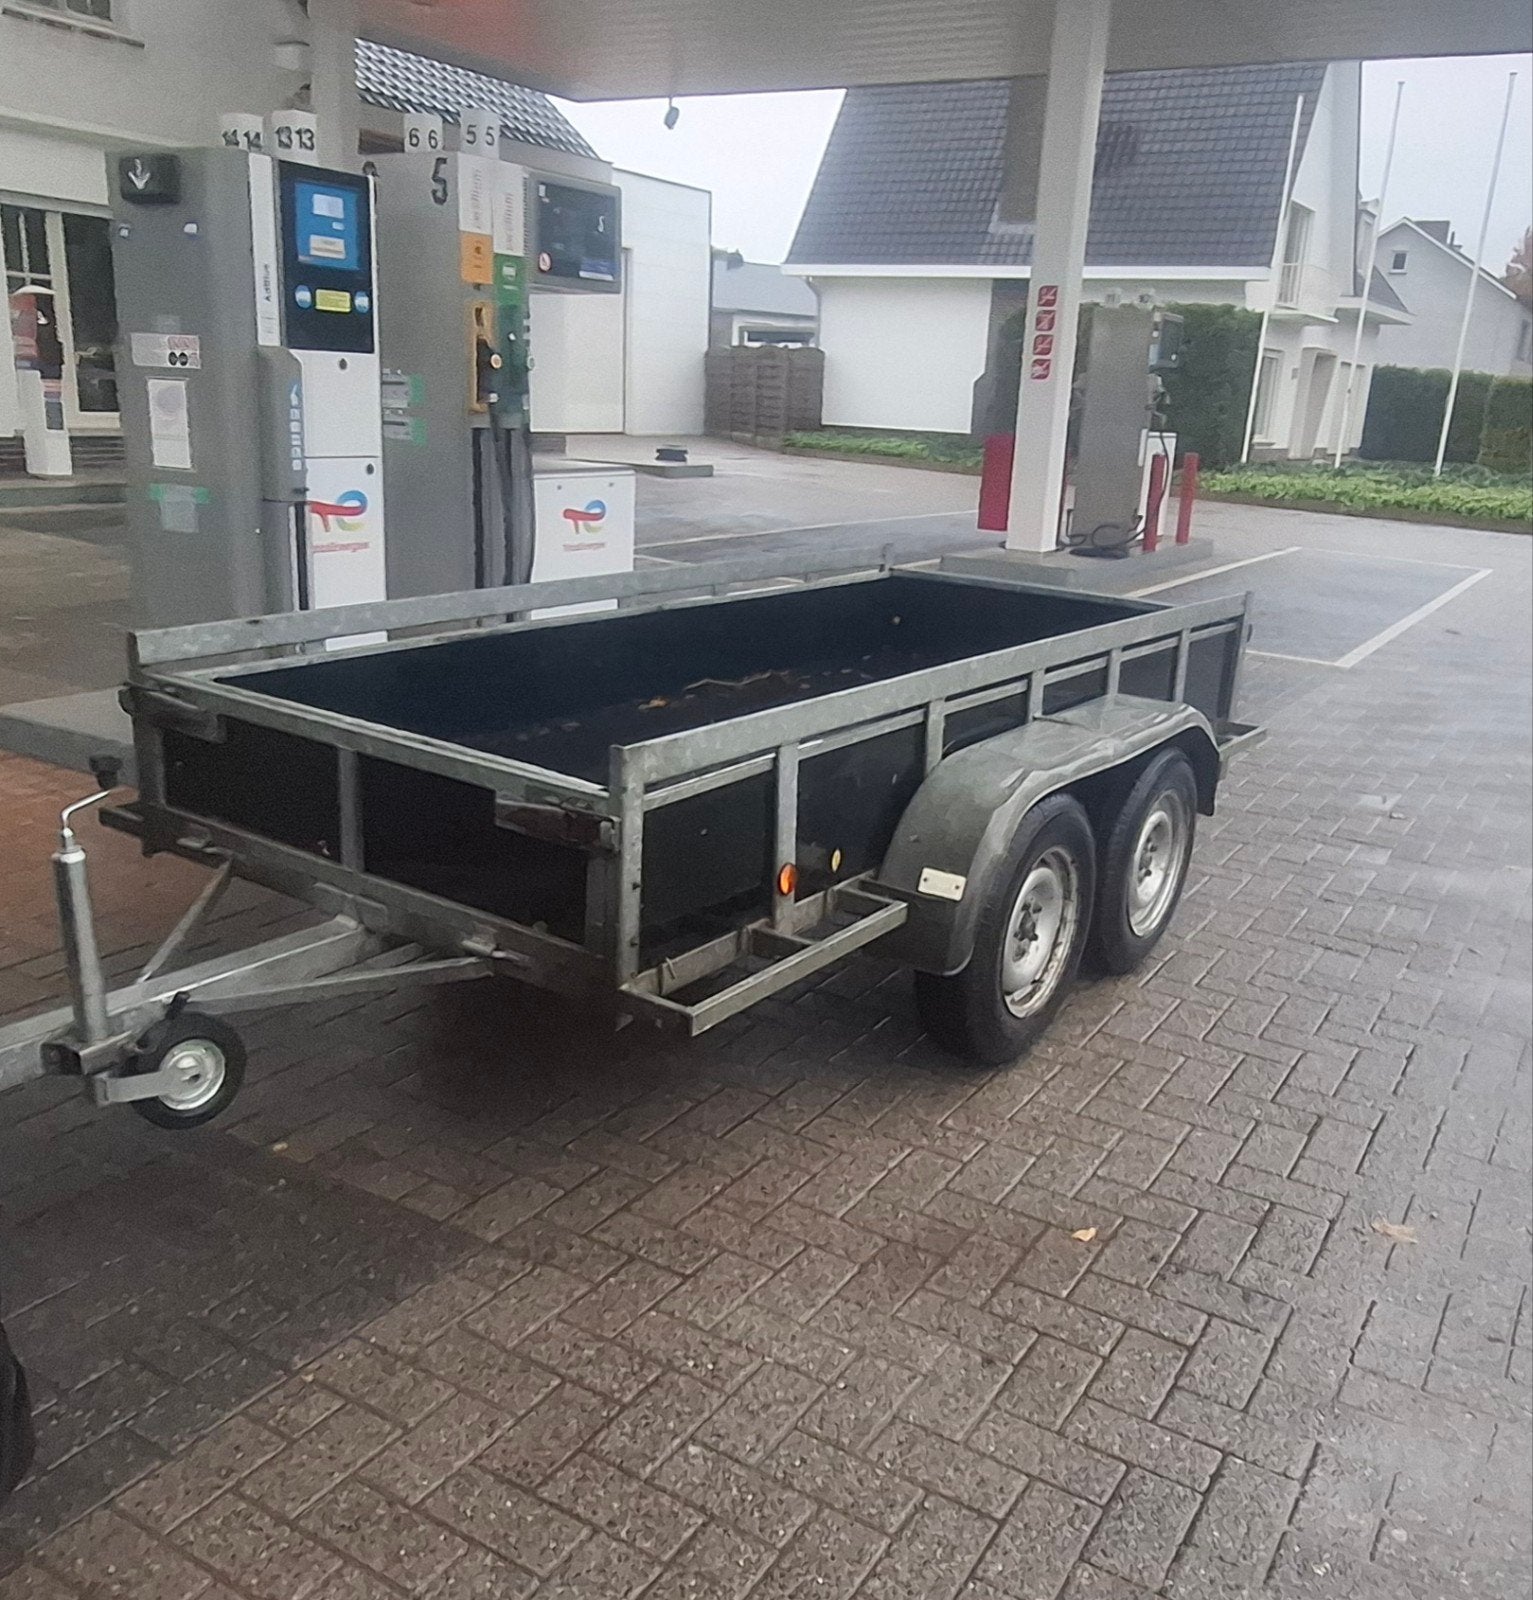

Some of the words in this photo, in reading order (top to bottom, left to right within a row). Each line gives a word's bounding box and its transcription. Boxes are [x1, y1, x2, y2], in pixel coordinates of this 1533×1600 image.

[295, 127, 315, 151] 13
[408, 127, 420, 148] 6
[427, 129, 439, 150] 6
[465, 124, 478, 145] 5
[485, 126, 496, 146] 5
[431, 157, 449, 205] 5
